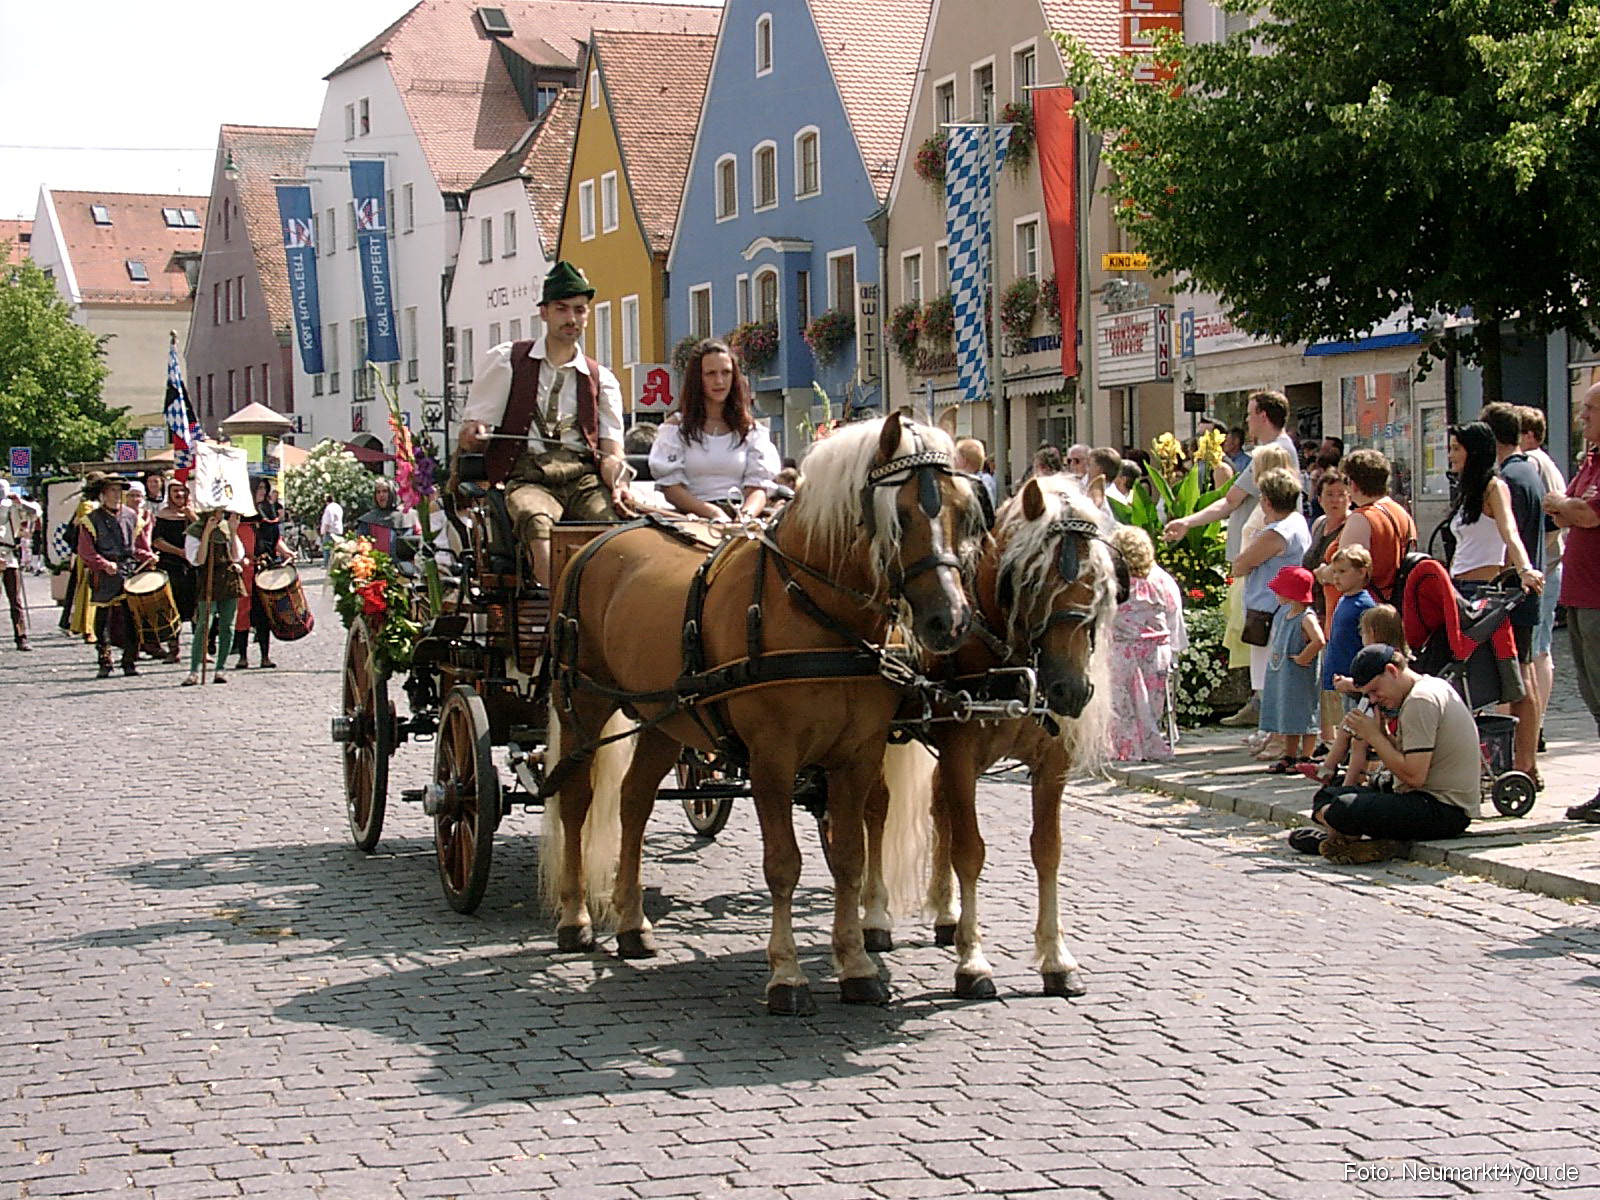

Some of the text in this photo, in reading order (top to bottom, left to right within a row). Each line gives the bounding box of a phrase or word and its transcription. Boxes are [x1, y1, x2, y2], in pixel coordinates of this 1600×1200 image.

[370, 236, 390, 337] K&L RUPPERT
[1109, 257, 1131, 267] KINO
[487, 286, 510, 309] HOTEL
[861, 303, 877, 377] WITTL
[1158, 309, 1168, 376] KINO
[1183, 317, 1192, 353] P
